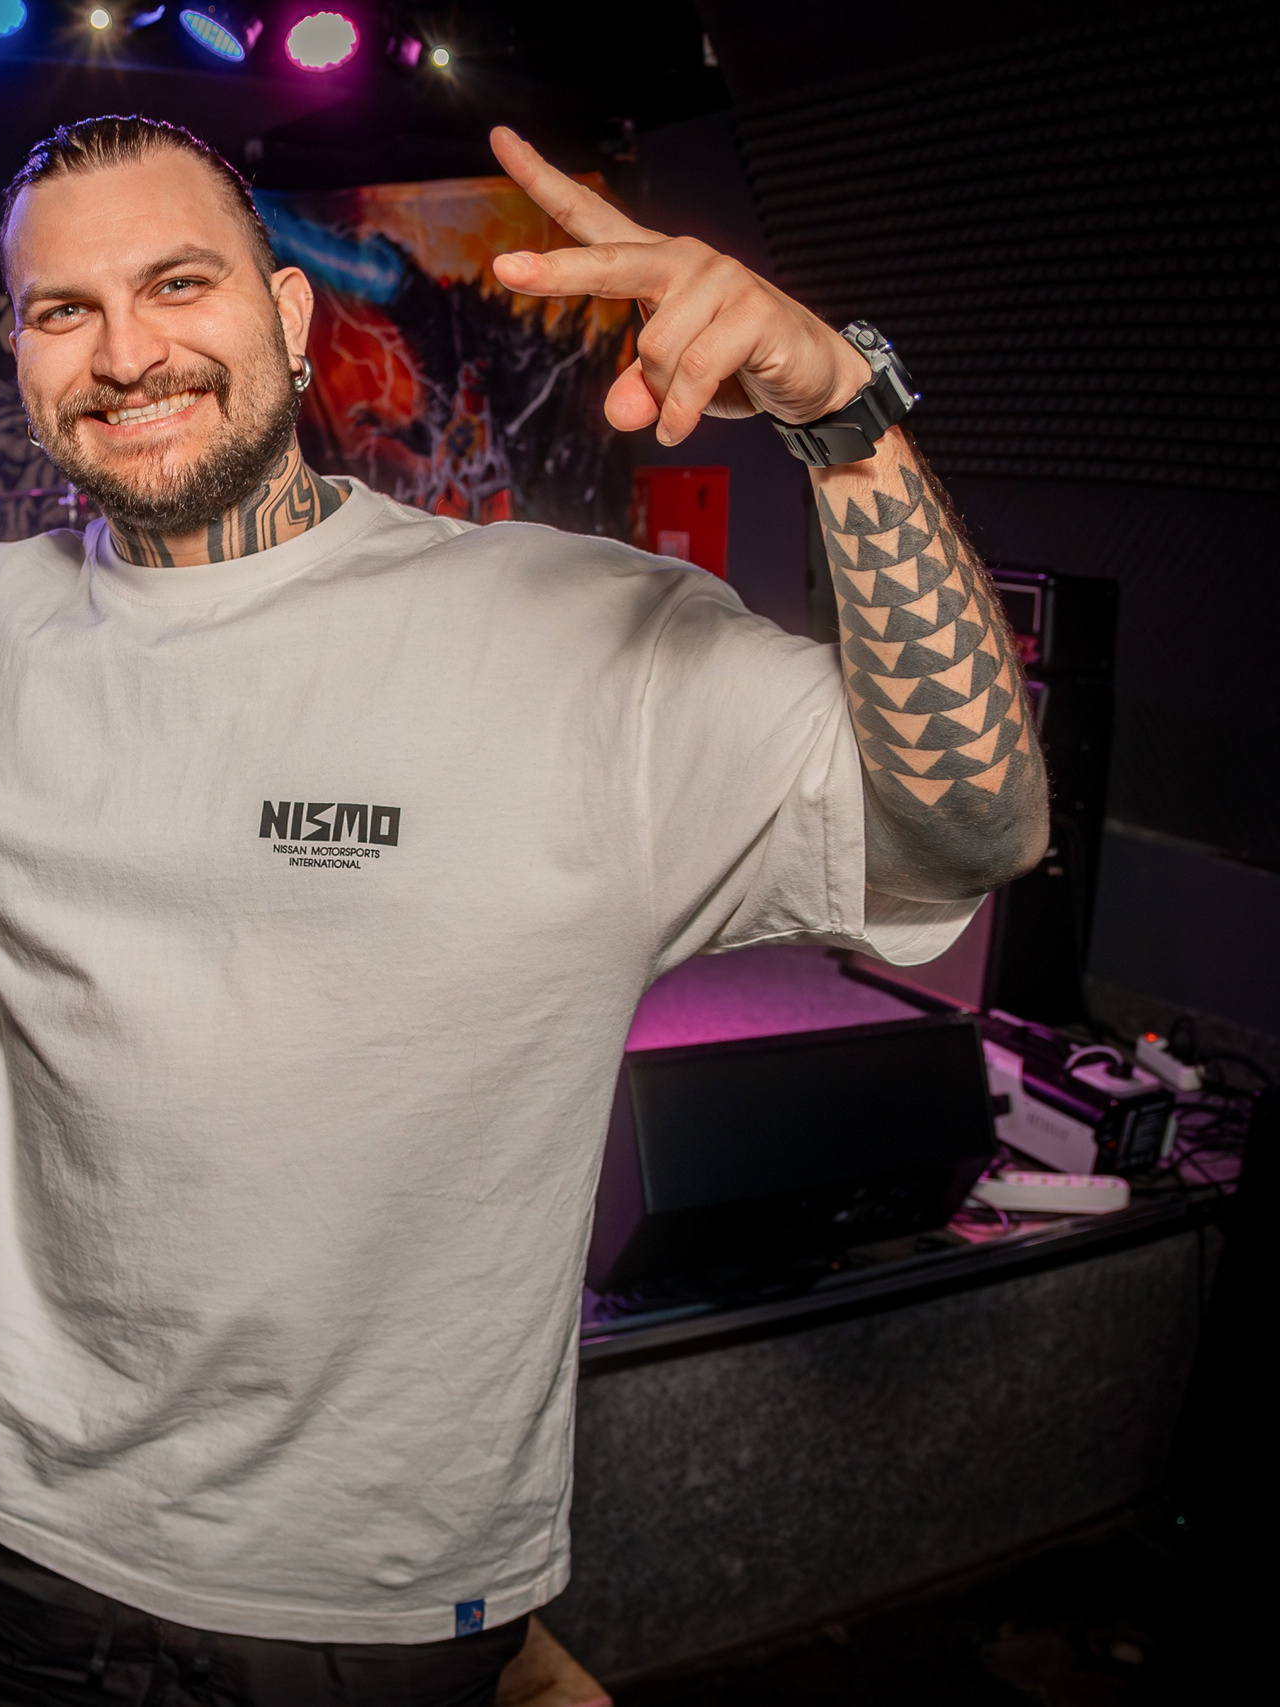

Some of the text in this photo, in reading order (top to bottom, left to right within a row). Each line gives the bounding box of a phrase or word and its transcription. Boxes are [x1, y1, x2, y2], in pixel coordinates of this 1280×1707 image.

[259, 800, 401, 846] NISMO
[272, 844, 380, 859] NISSAN MOTORSPORTS
[289, 857, 361, 869] INTERNATIONAL
